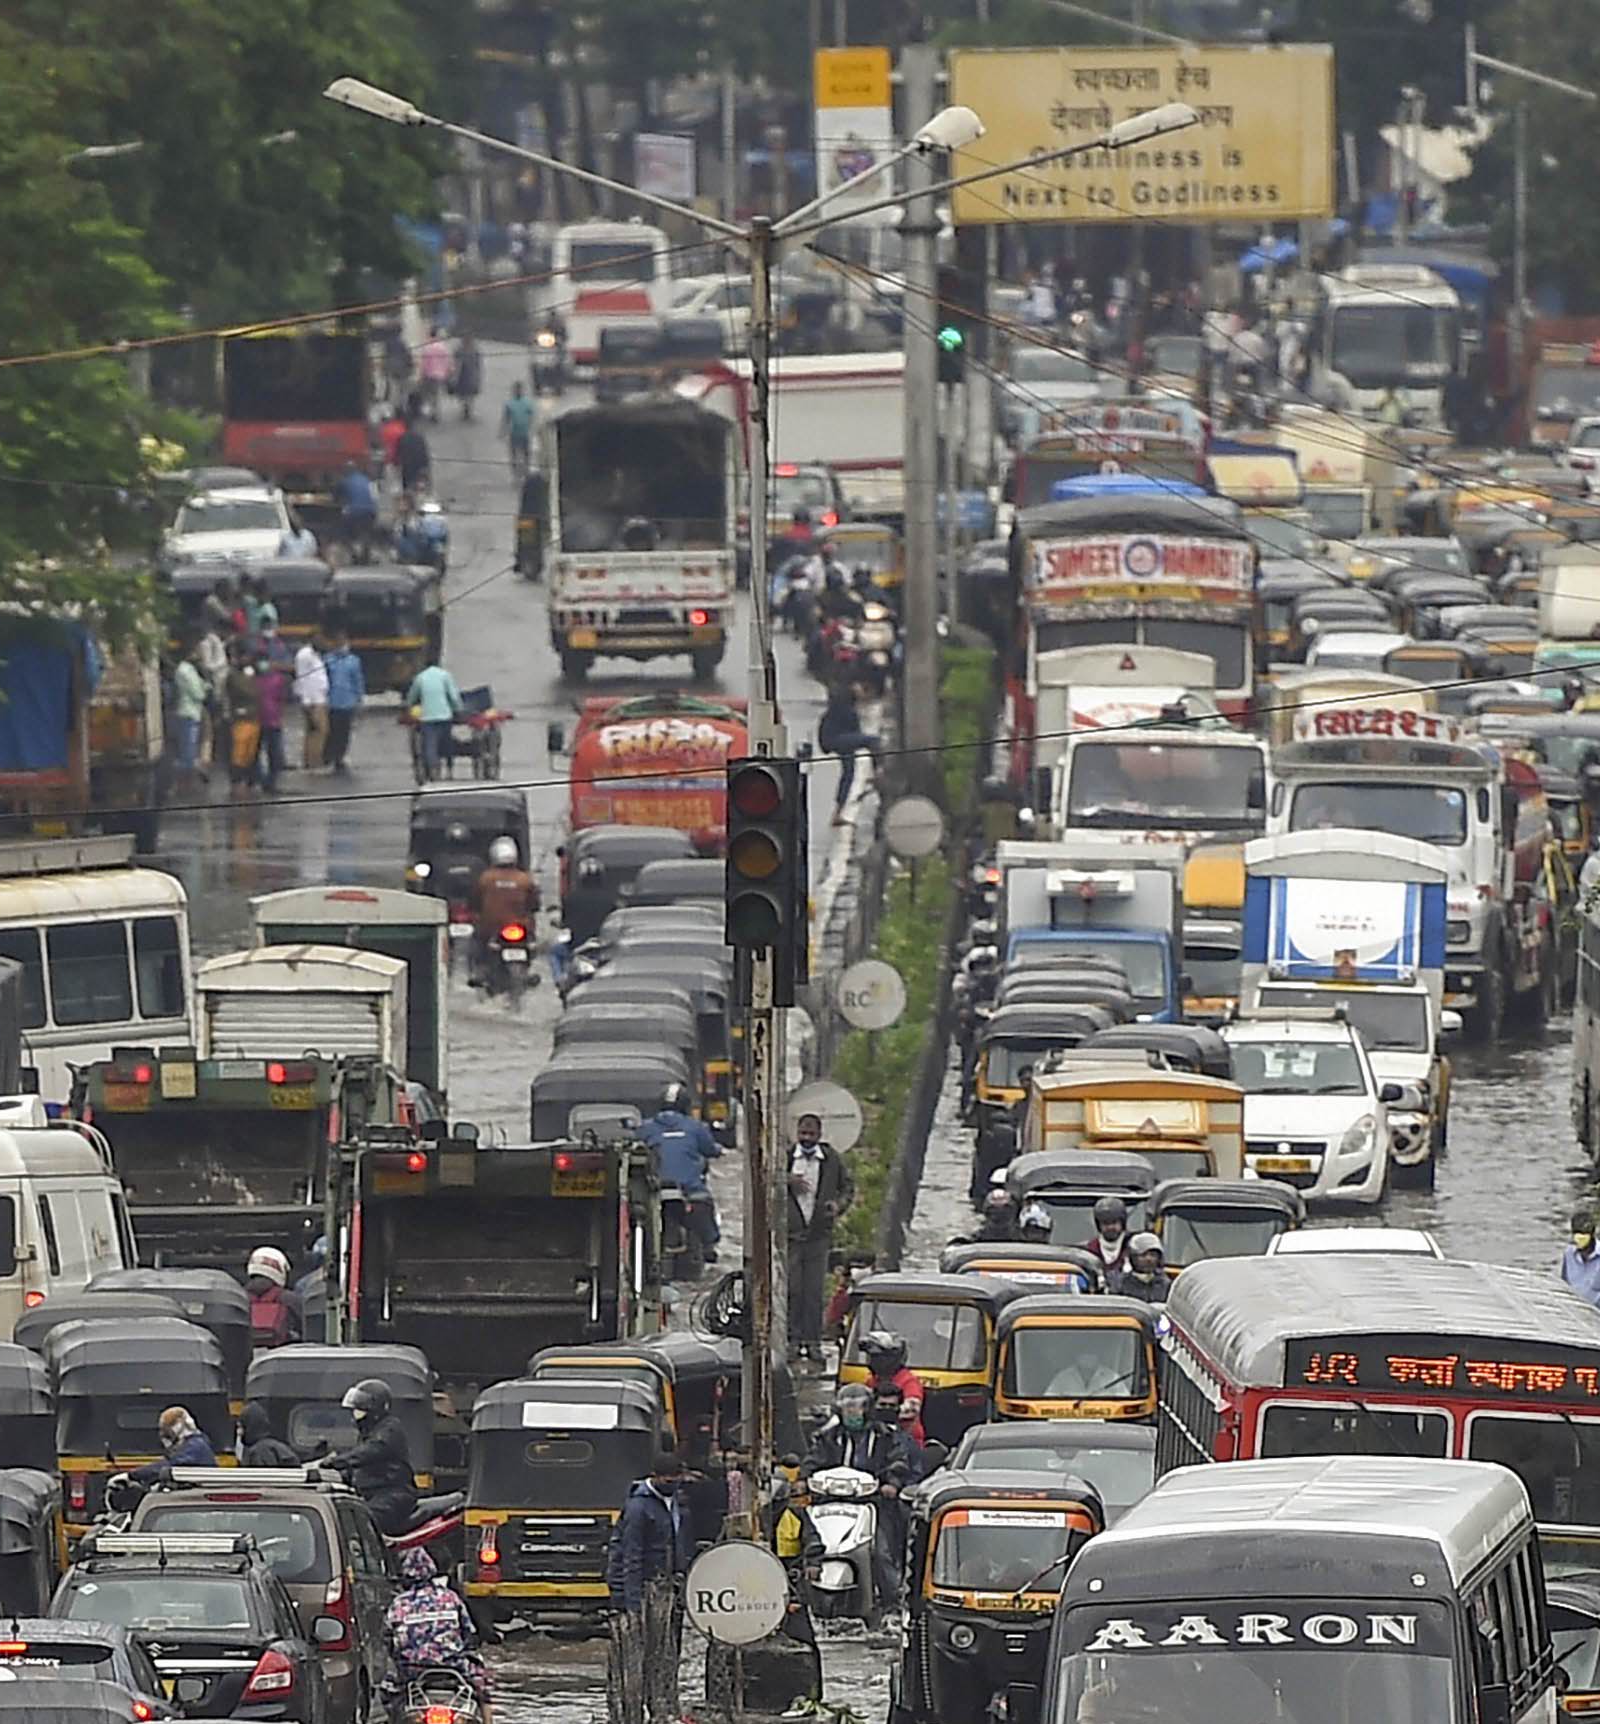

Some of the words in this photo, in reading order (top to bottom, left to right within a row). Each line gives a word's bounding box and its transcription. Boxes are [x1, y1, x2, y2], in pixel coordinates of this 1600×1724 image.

[1029, 145, 1203, 170] Cleanliness
[1222, 144, 1243, 168] is
[1004, 182, 1068, 207] Next
[1087, 182, 1115, 205] to
[1131, 180, 1280, 205] Godliness
[696, 1589, 736, 1614] RC
[1085, 1614, 1418, 1651] AARON
